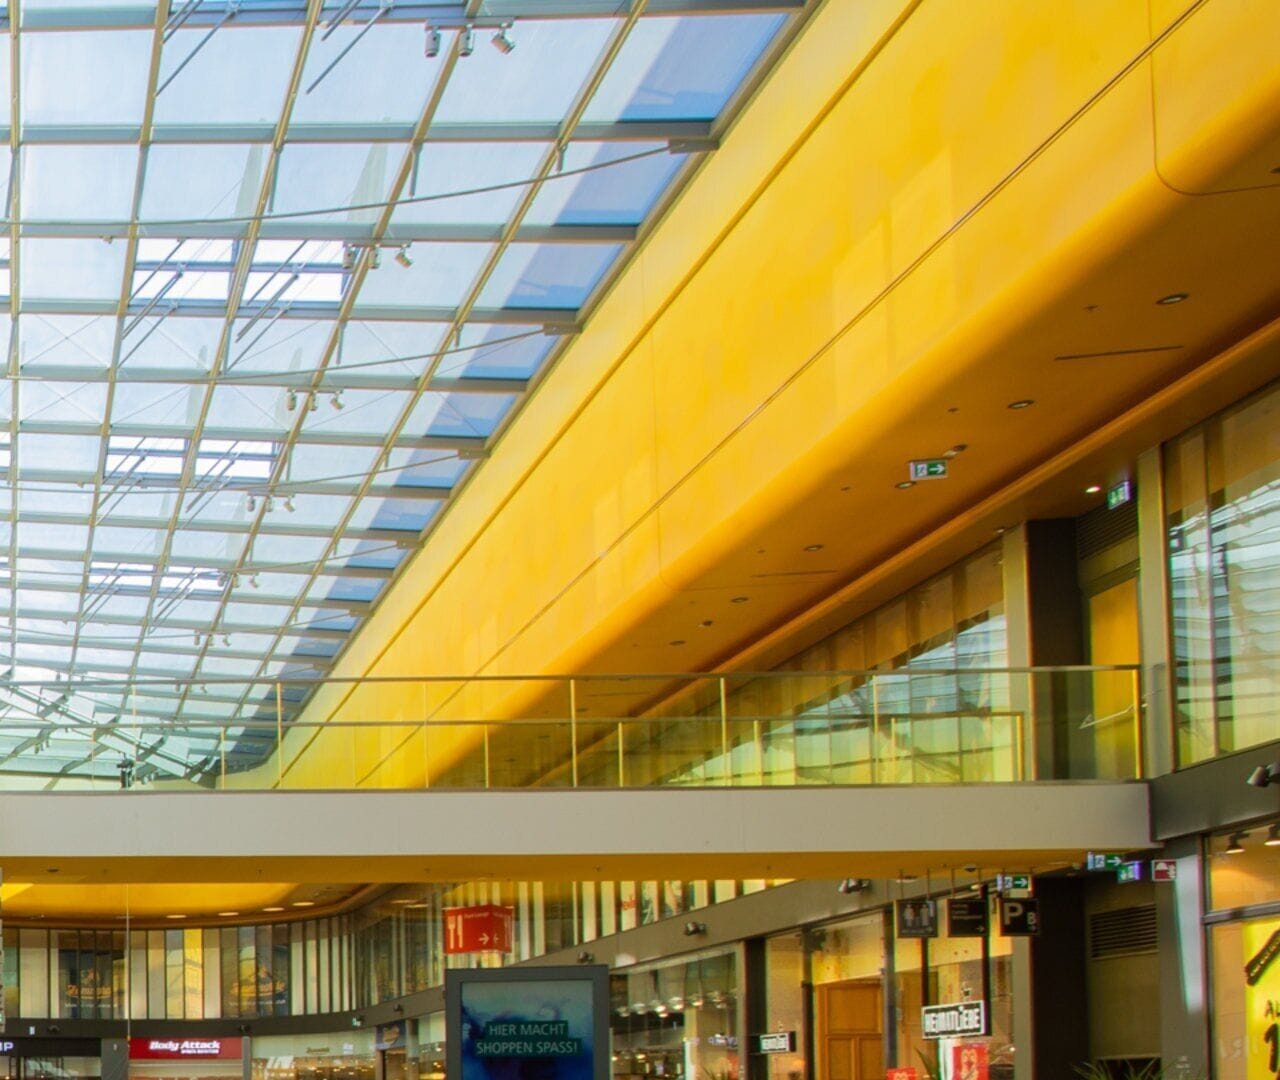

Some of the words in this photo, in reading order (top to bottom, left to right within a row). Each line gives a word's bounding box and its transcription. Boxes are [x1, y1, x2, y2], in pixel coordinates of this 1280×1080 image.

[489, 1023, 517, 1036] HIER
[520, 1023, 565, 1036] MACHT
[149, 1041, 180, 1052] Body
[181, 1040, 221, 1051] Attack
[476, 1041, 533, 1055] SHOPPEN
[536, 1041, 578, 1054] SPASS!
